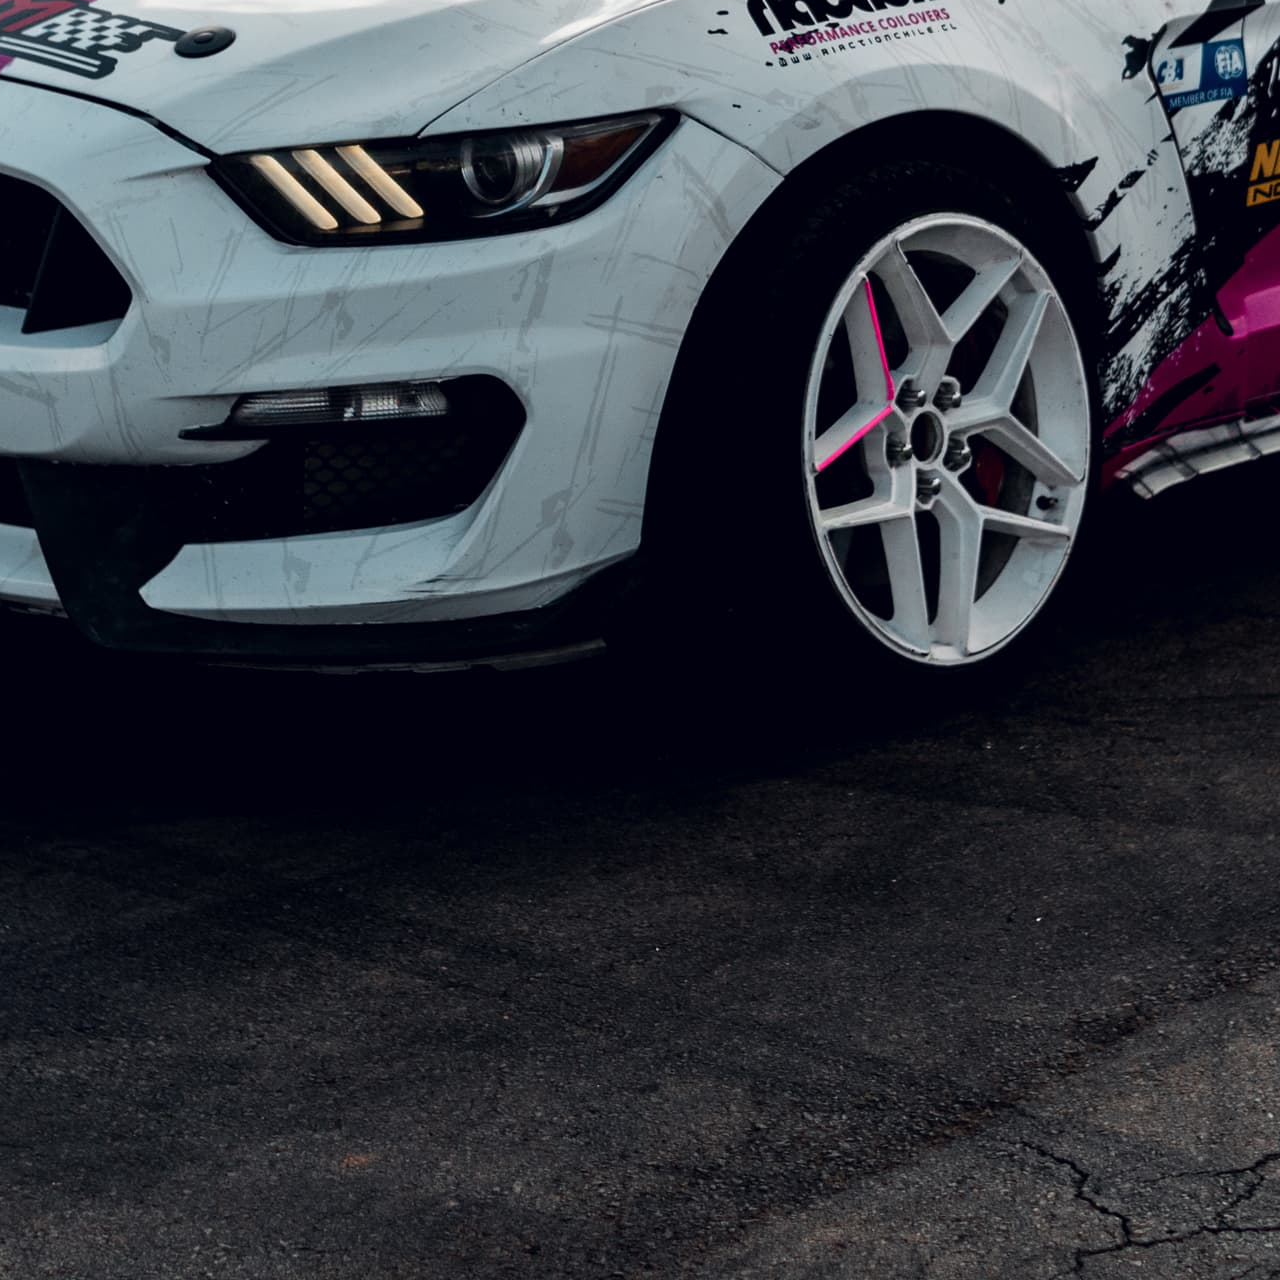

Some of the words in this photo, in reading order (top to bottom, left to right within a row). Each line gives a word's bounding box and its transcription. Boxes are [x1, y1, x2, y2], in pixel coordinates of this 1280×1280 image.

[878, 8, 951, 32] COILOVERS
[770, 21, 877, 55] PERFORMANCE
[1216, 49, 1244, 75] FIA
[1170, 92, 1205, 108] MEMBER
[1207, 90, 1219, 101] OF
[1221, 87, 1233, 99] FIA
